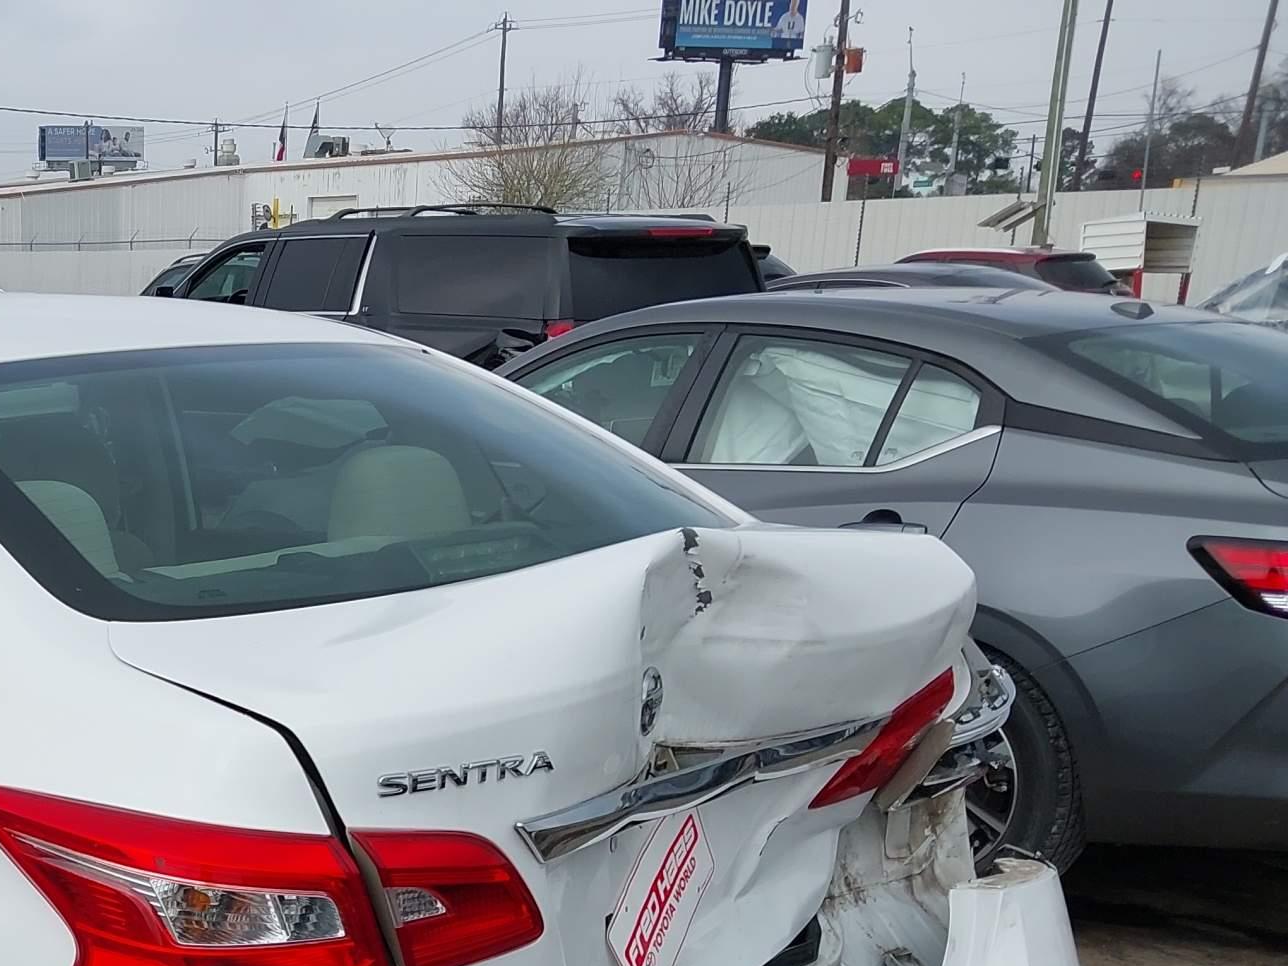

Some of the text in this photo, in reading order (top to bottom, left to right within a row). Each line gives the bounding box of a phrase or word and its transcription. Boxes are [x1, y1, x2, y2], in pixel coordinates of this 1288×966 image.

[679, 0, 774, 28] MIKE DOYLE
[54, 127, 75, 136] SAFER
[376, 749, 555, 798] SENTRA
[652, 856, 697, 953] TOYOTA WORLD
